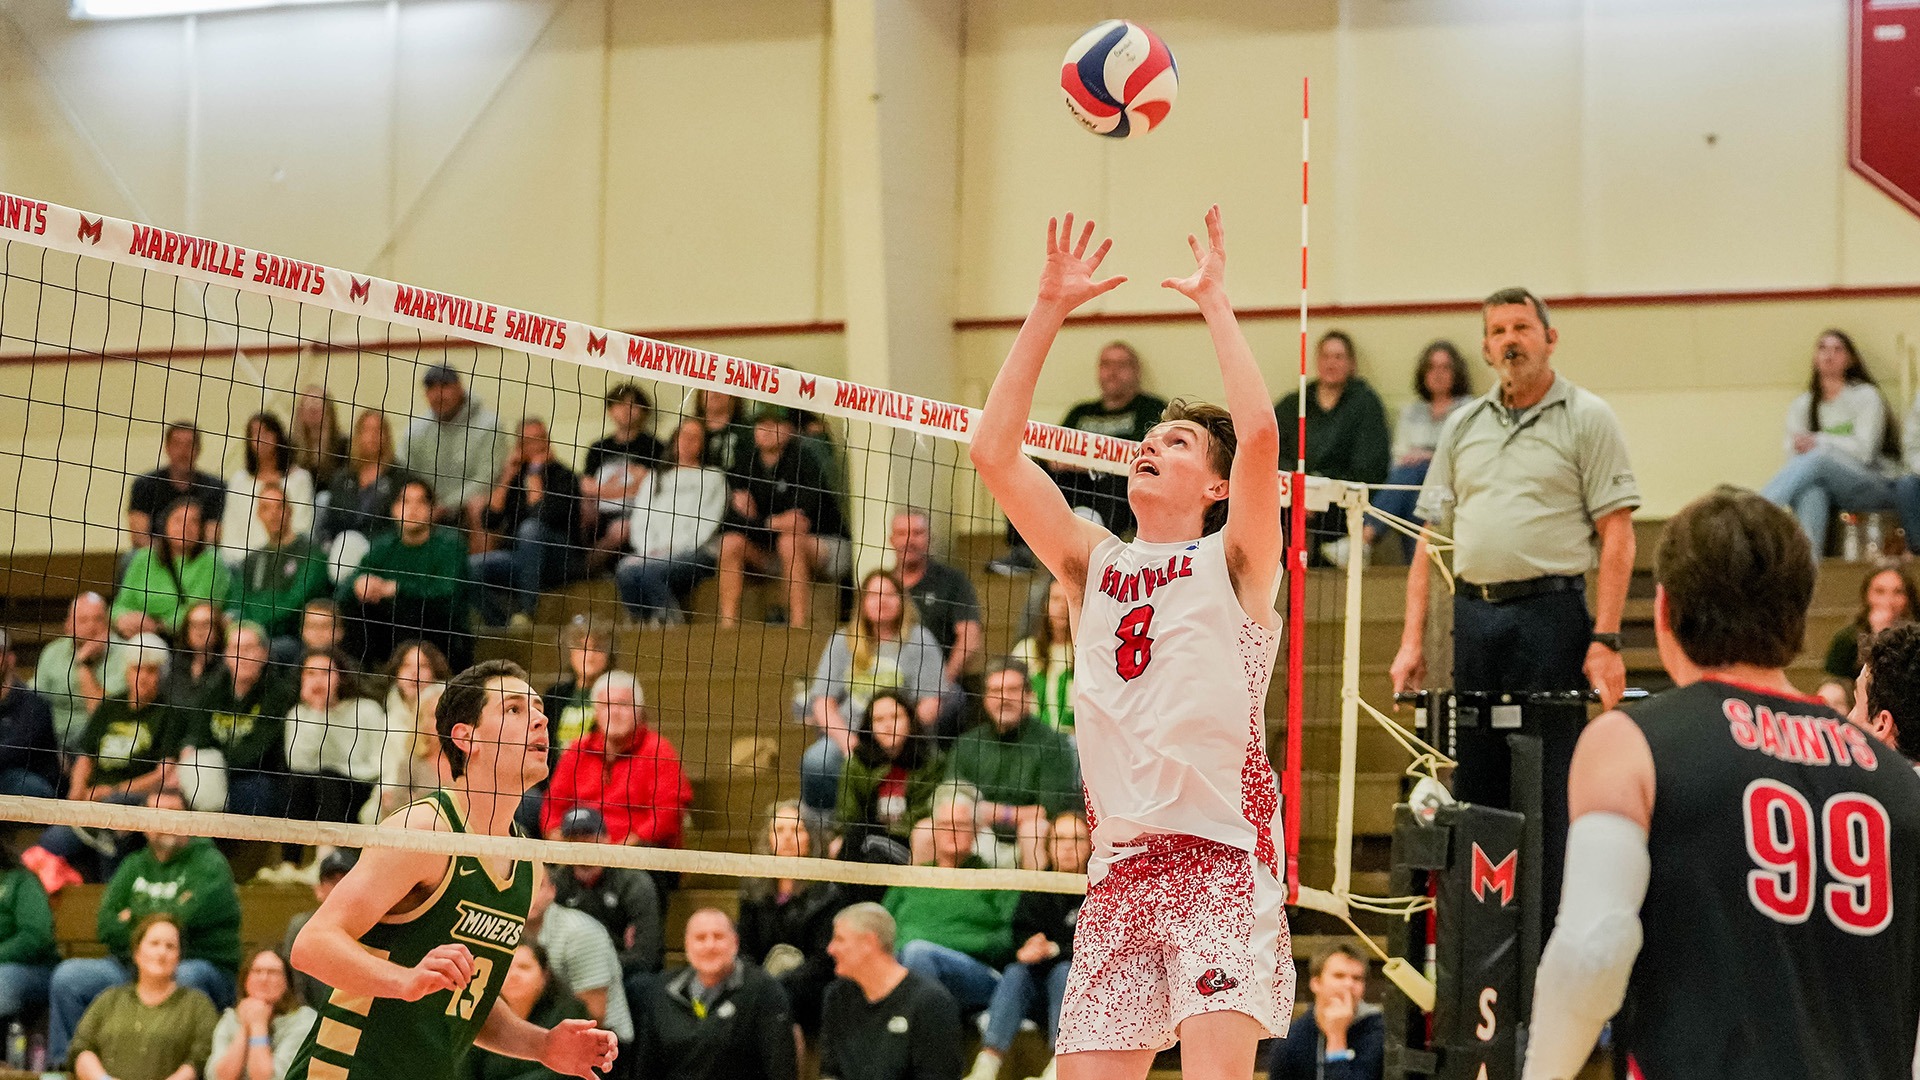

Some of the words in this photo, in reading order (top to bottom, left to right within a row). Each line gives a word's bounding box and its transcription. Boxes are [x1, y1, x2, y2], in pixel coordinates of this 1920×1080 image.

[0, 194, 47, 236] INTS
[77, 213, 104, 245] M
[129, 224, 246, 278] MARYVILLE
[253, 252, 325, 295] SAINTS
[349, 274, 371, 305] M
[393, 284, 498, 334] MARYVILLE
[504, 310, 567, 350] SAINTS
[586, 329, 608, 358] M
[627, 337, 719, 381] MARYVILLE
[725, 358, 780, 394] SAINTS
[799, 374, 816, 400] M
[834, 380, 915, 421] MARYVILLE
[920, 399, 969, 433] SAINTS
[1115, 603, 1155, 683] 8
[1722, 697, 1879, 772] SAINTS
[1471, 841, 1518, 907] M
[1742, 777, 1894, 937] 99
[460, 908, 524, 946] MINERS
